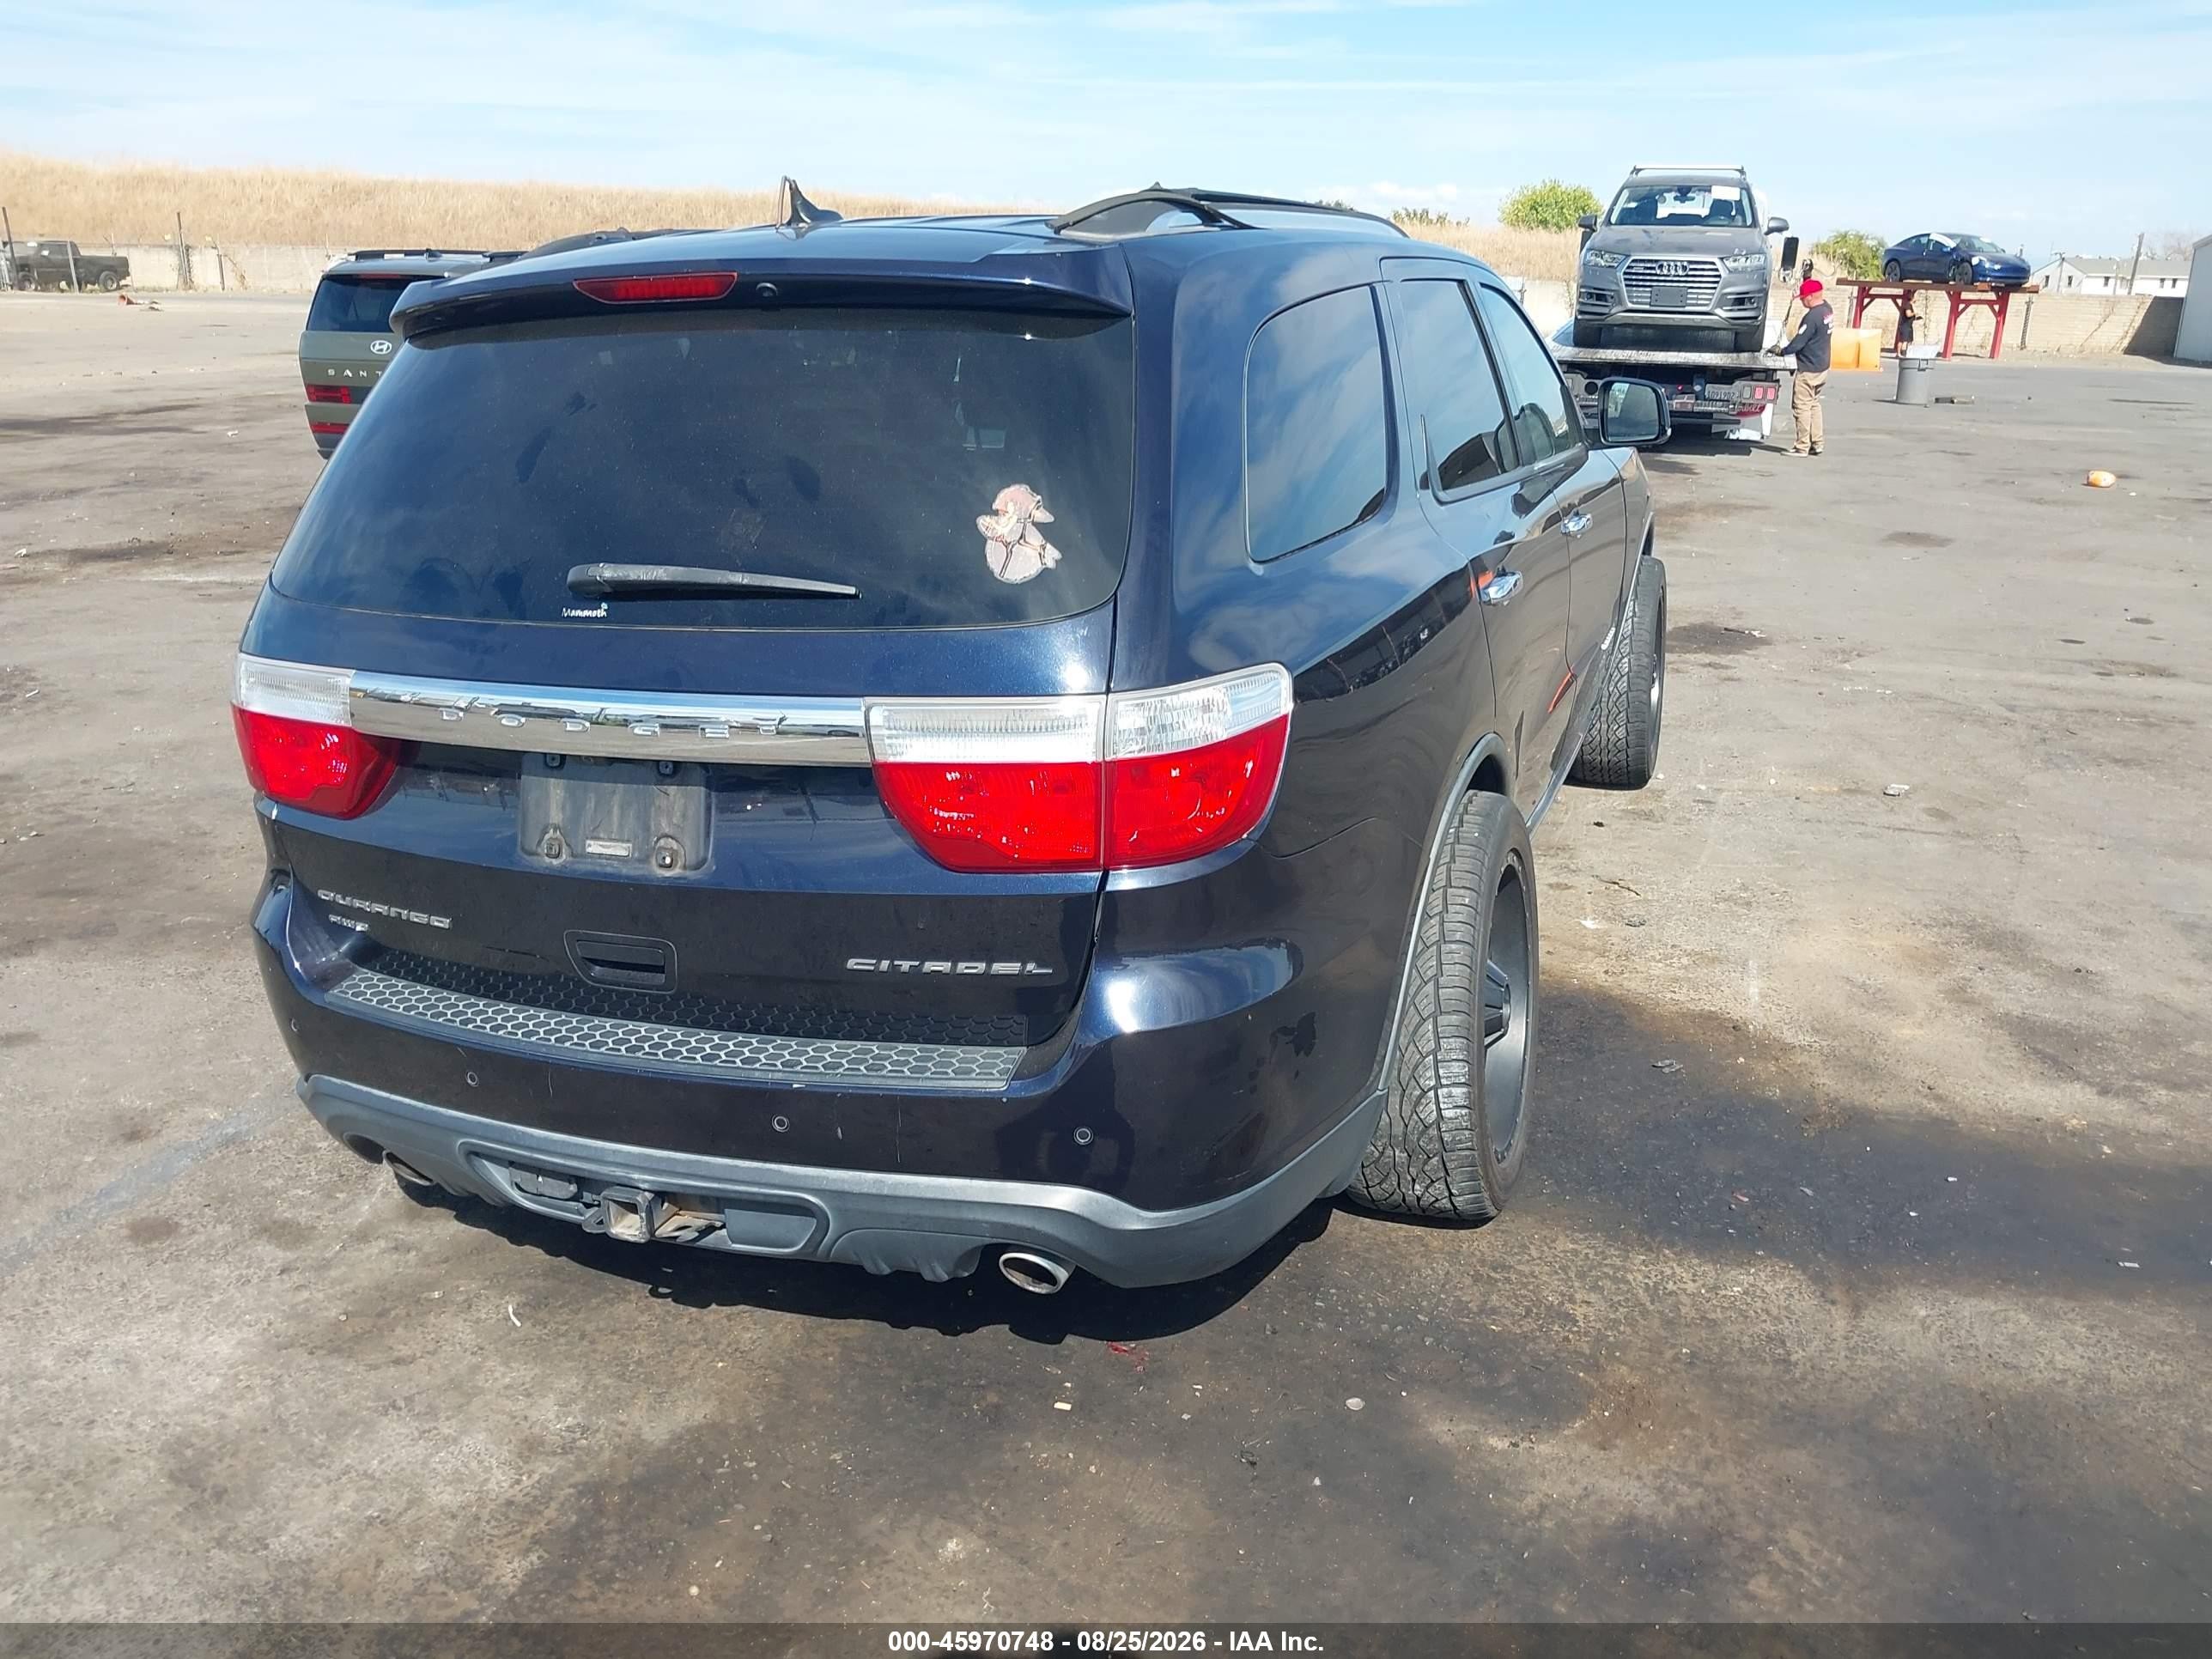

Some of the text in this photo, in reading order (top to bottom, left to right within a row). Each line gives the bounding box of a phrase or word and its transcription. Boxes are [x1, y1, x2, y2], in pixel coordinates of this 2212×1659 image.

[561, 606, 607, 618] Mammoth
[317, 889, 453, 930] DURANGO
[328, 914, 369, 933] AWD
[846, 958, 1054, 976] CITADEL
